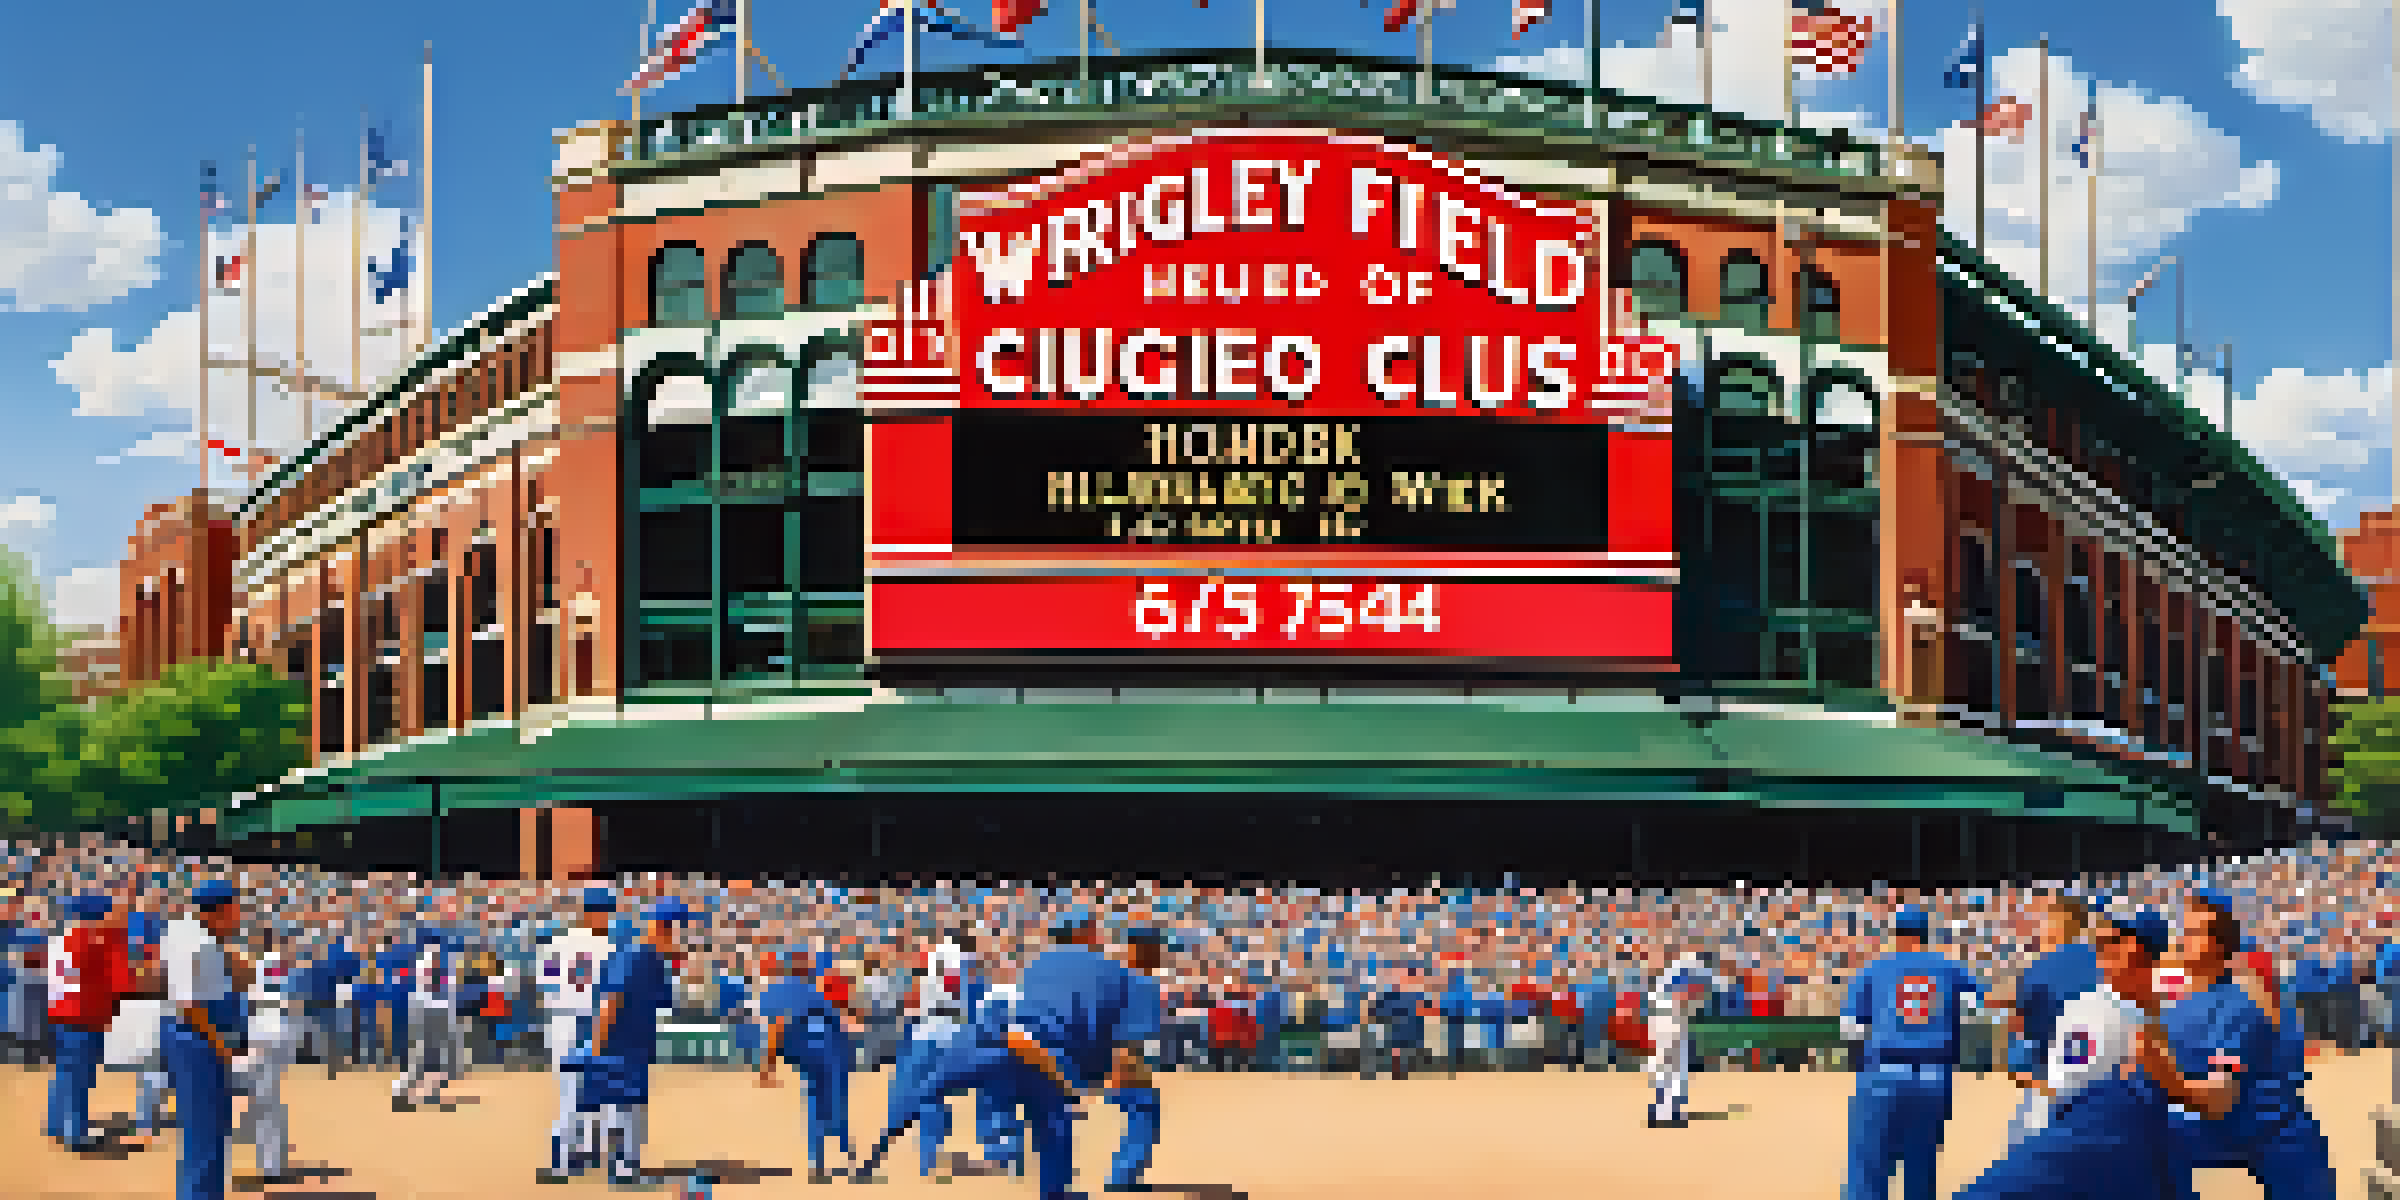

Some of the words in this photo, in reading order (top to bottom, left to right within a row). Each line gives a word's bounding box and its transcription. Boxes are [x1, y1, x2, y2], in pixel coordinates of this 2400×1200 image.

[960, 160, 1320, 304] WRIGLEY
[1351, 167, 1586, 306] FIELD
[1361, 264, 1432, 304] OF
[1368, 335, 1577, 408] CLUS
